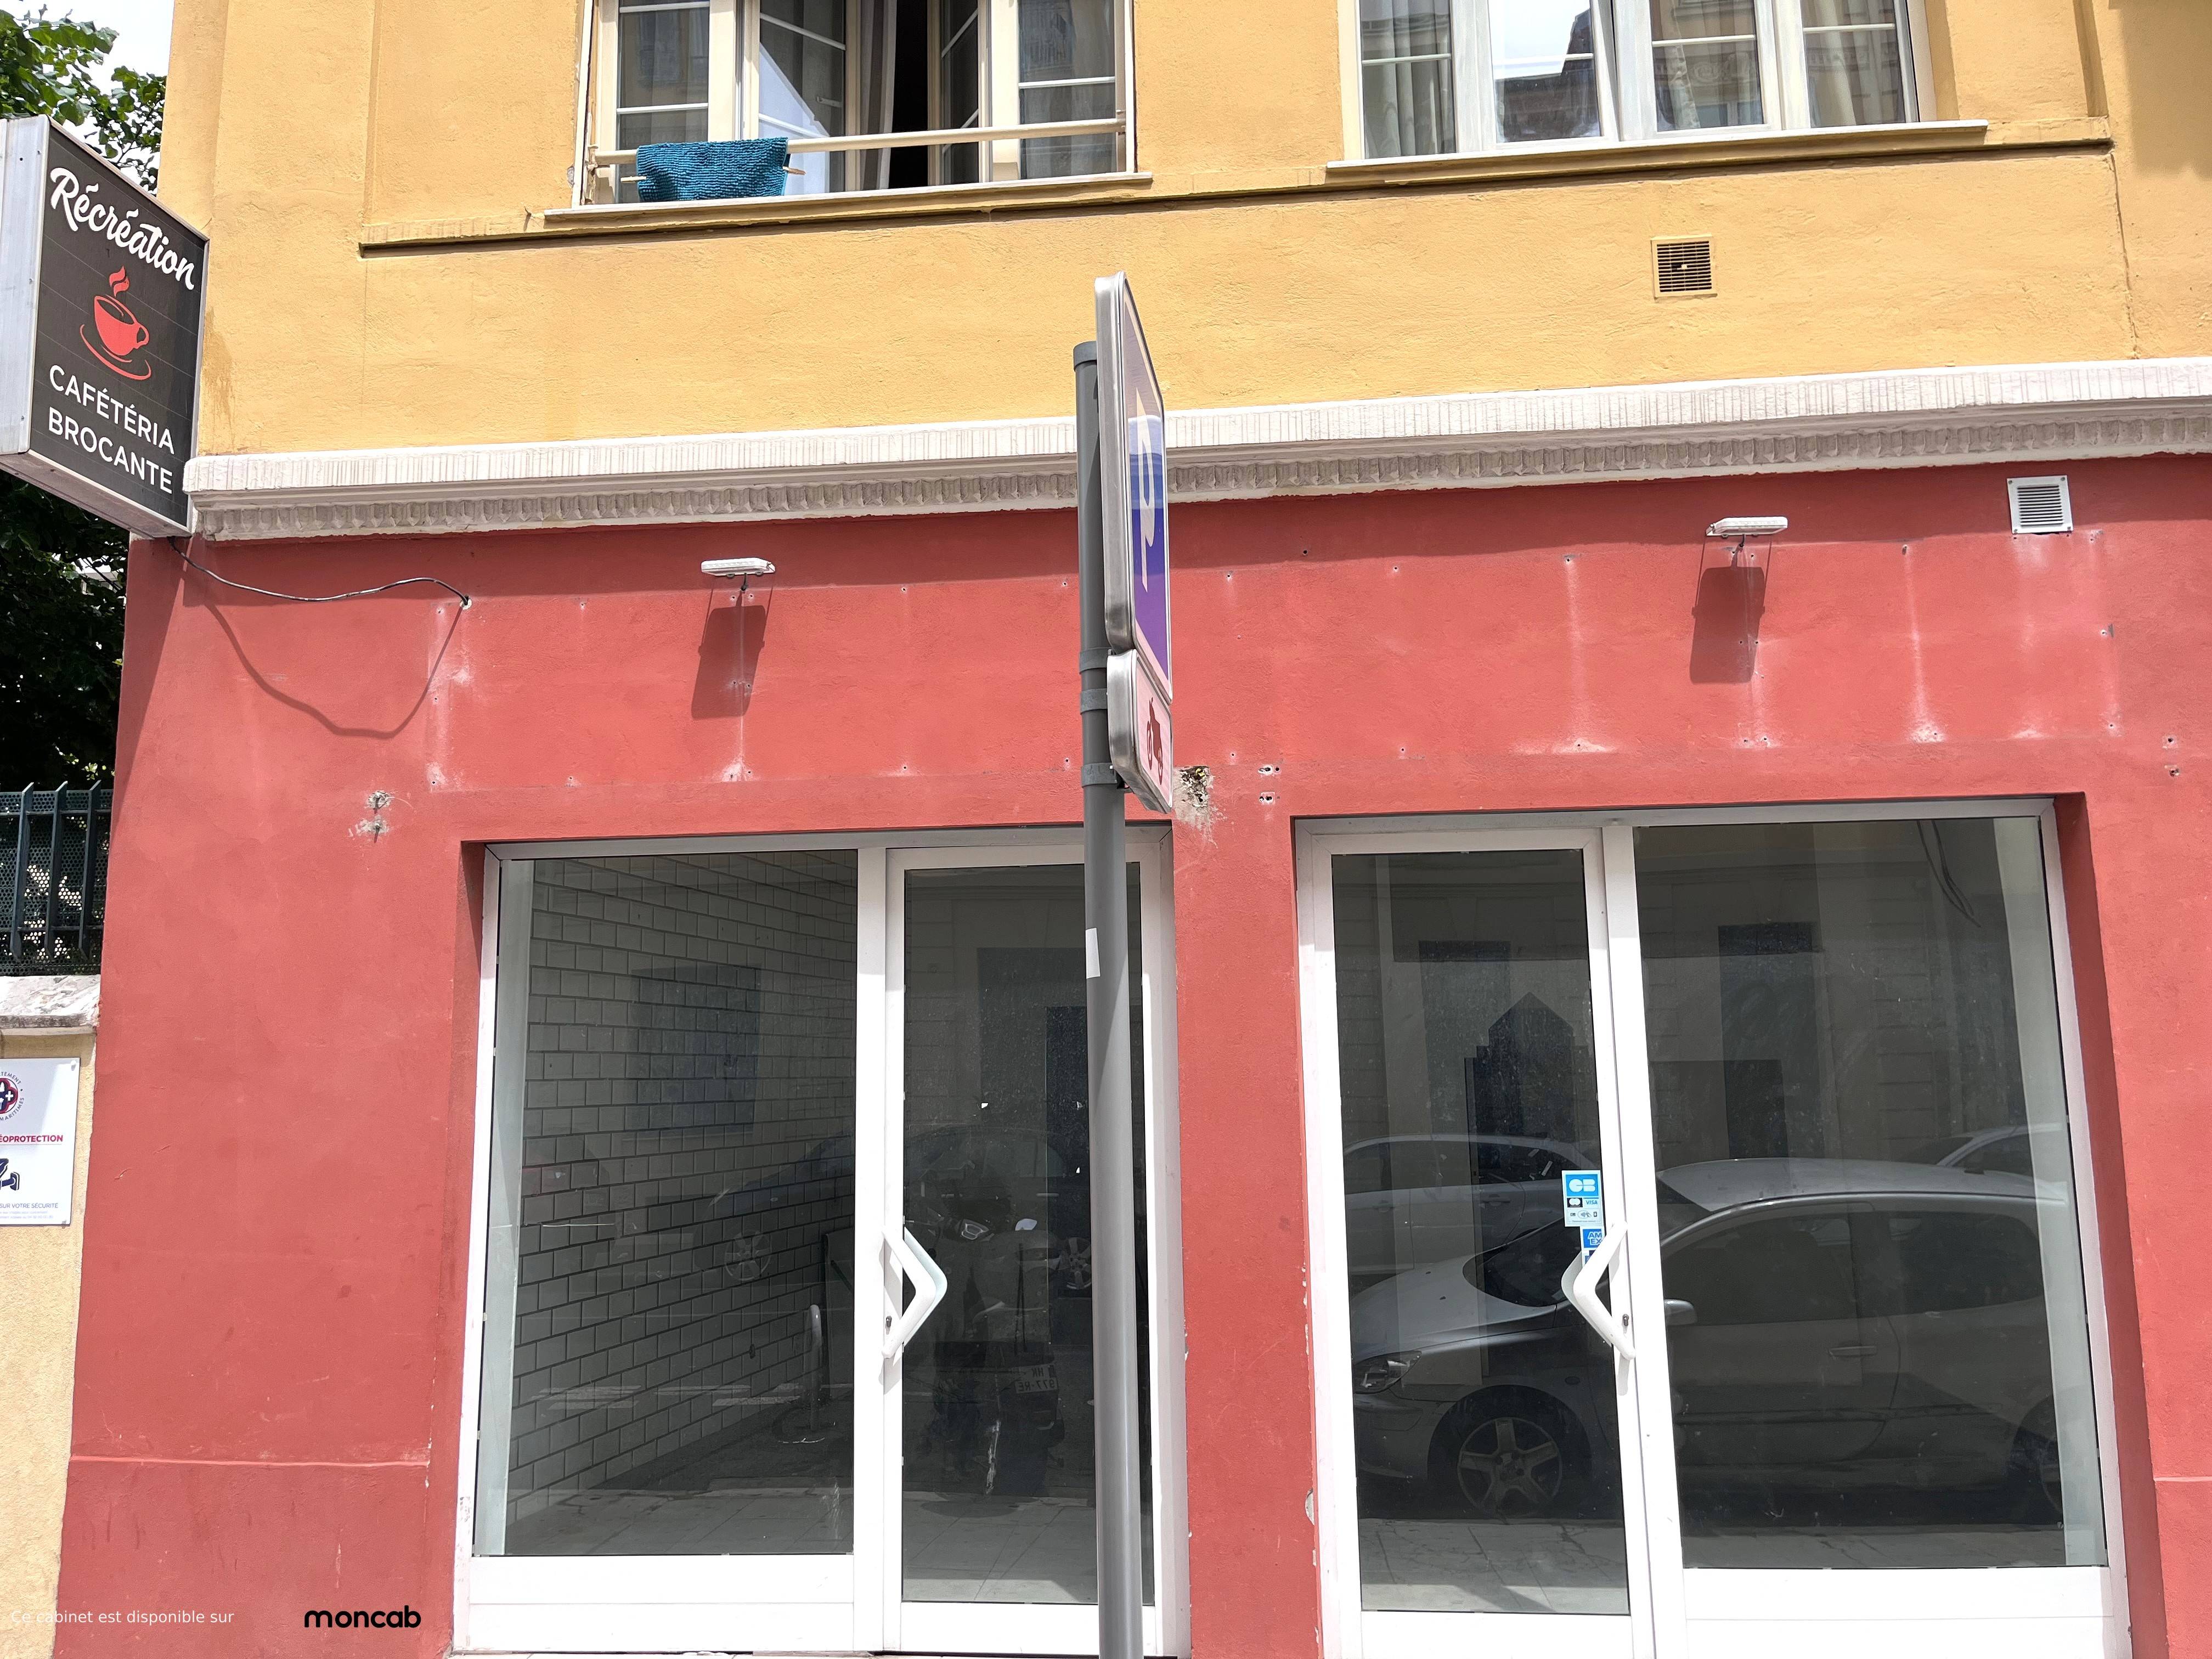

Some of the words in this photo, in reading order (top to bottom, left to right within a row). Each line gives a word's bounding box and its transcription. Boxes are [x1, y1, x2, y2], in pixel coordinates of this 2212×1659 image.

[50, 167, 195, 290] Récréation
[49, 365, 174, 455] CAFÉTÉRIA
[49, 407, 173, 494] BROCANTE
[1136, 387, 1155, 593] P
[0, 1071, 21, 1085] TEMENT
